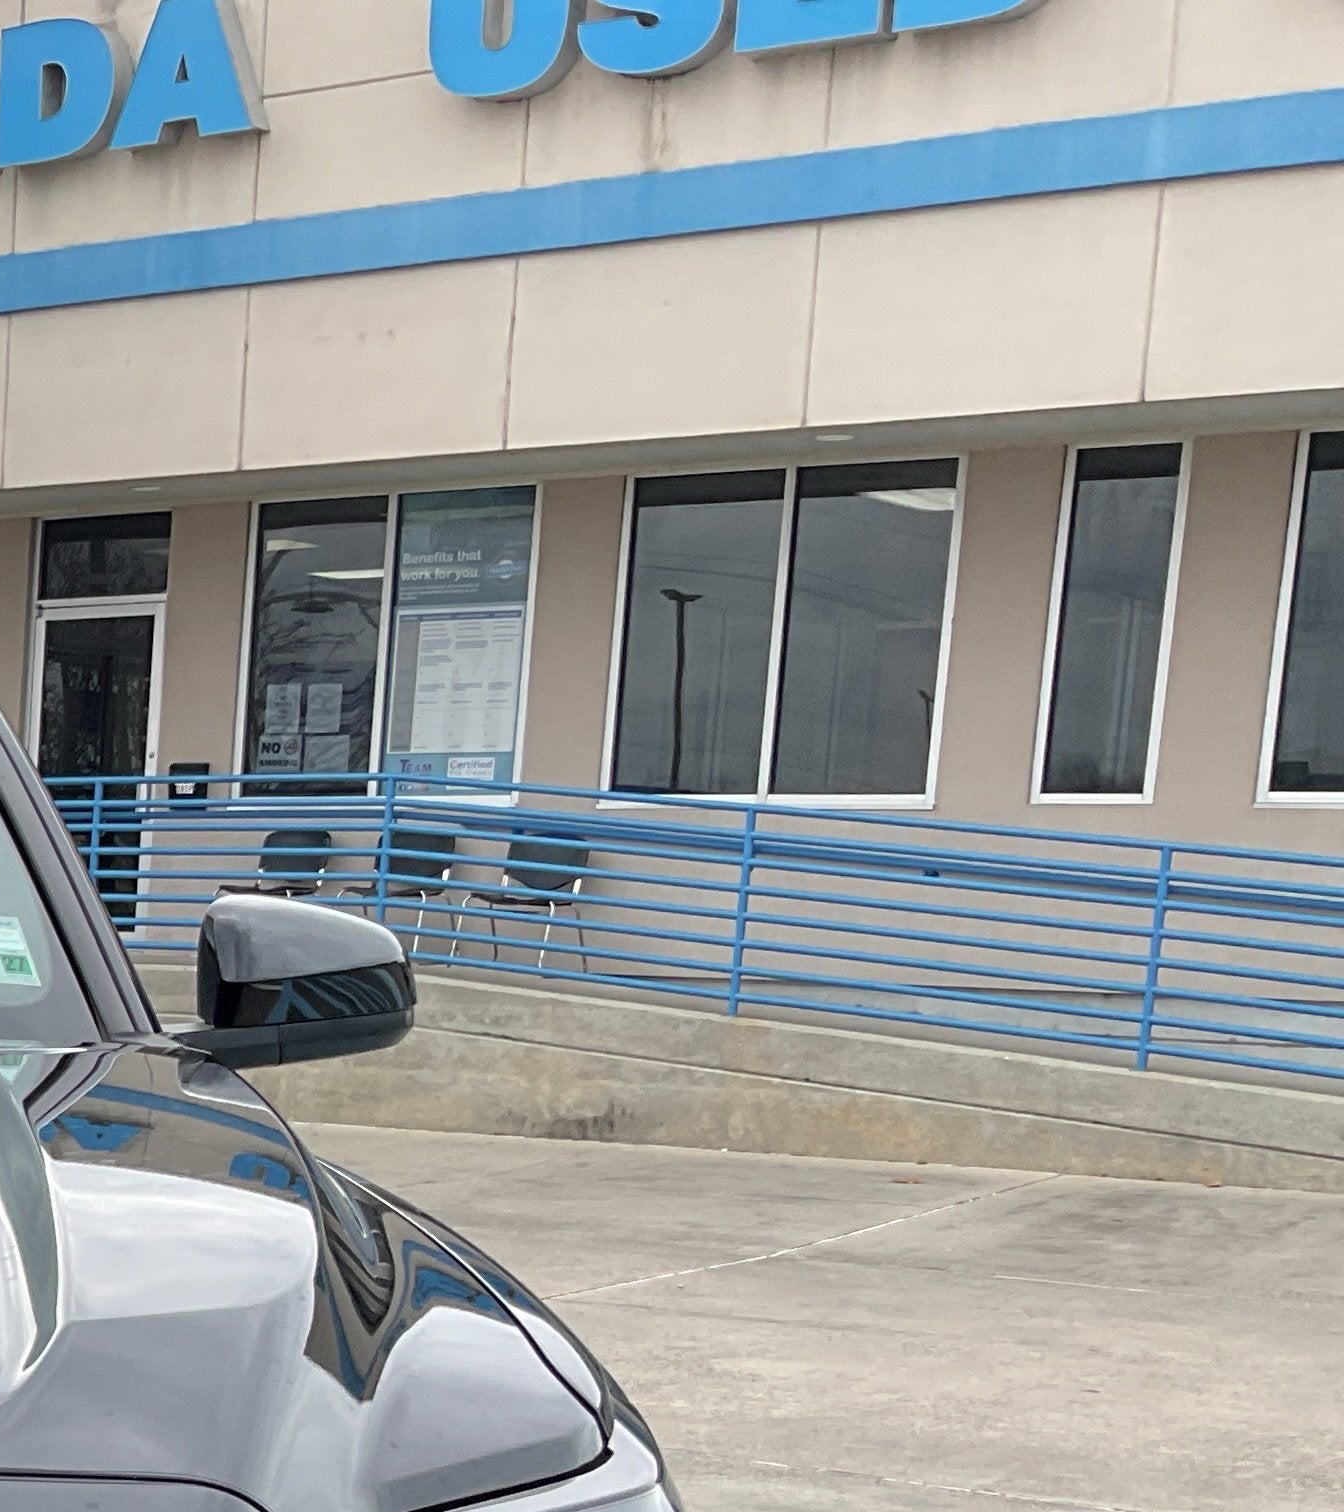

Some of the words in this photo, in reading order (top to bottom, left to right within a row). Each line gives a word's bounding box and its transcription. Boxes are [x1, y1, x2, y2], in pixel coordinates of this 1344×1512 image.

[402, 551, 454, 565] Benefits
[457, 550, 482, 561] that
[400, 568, 432, 581] work
[434, 567, 452, 579] for
[261, 742, 281, 754] NO
[449, 759, 493, 770] Certified
[2, 955, 25, 972] 27
